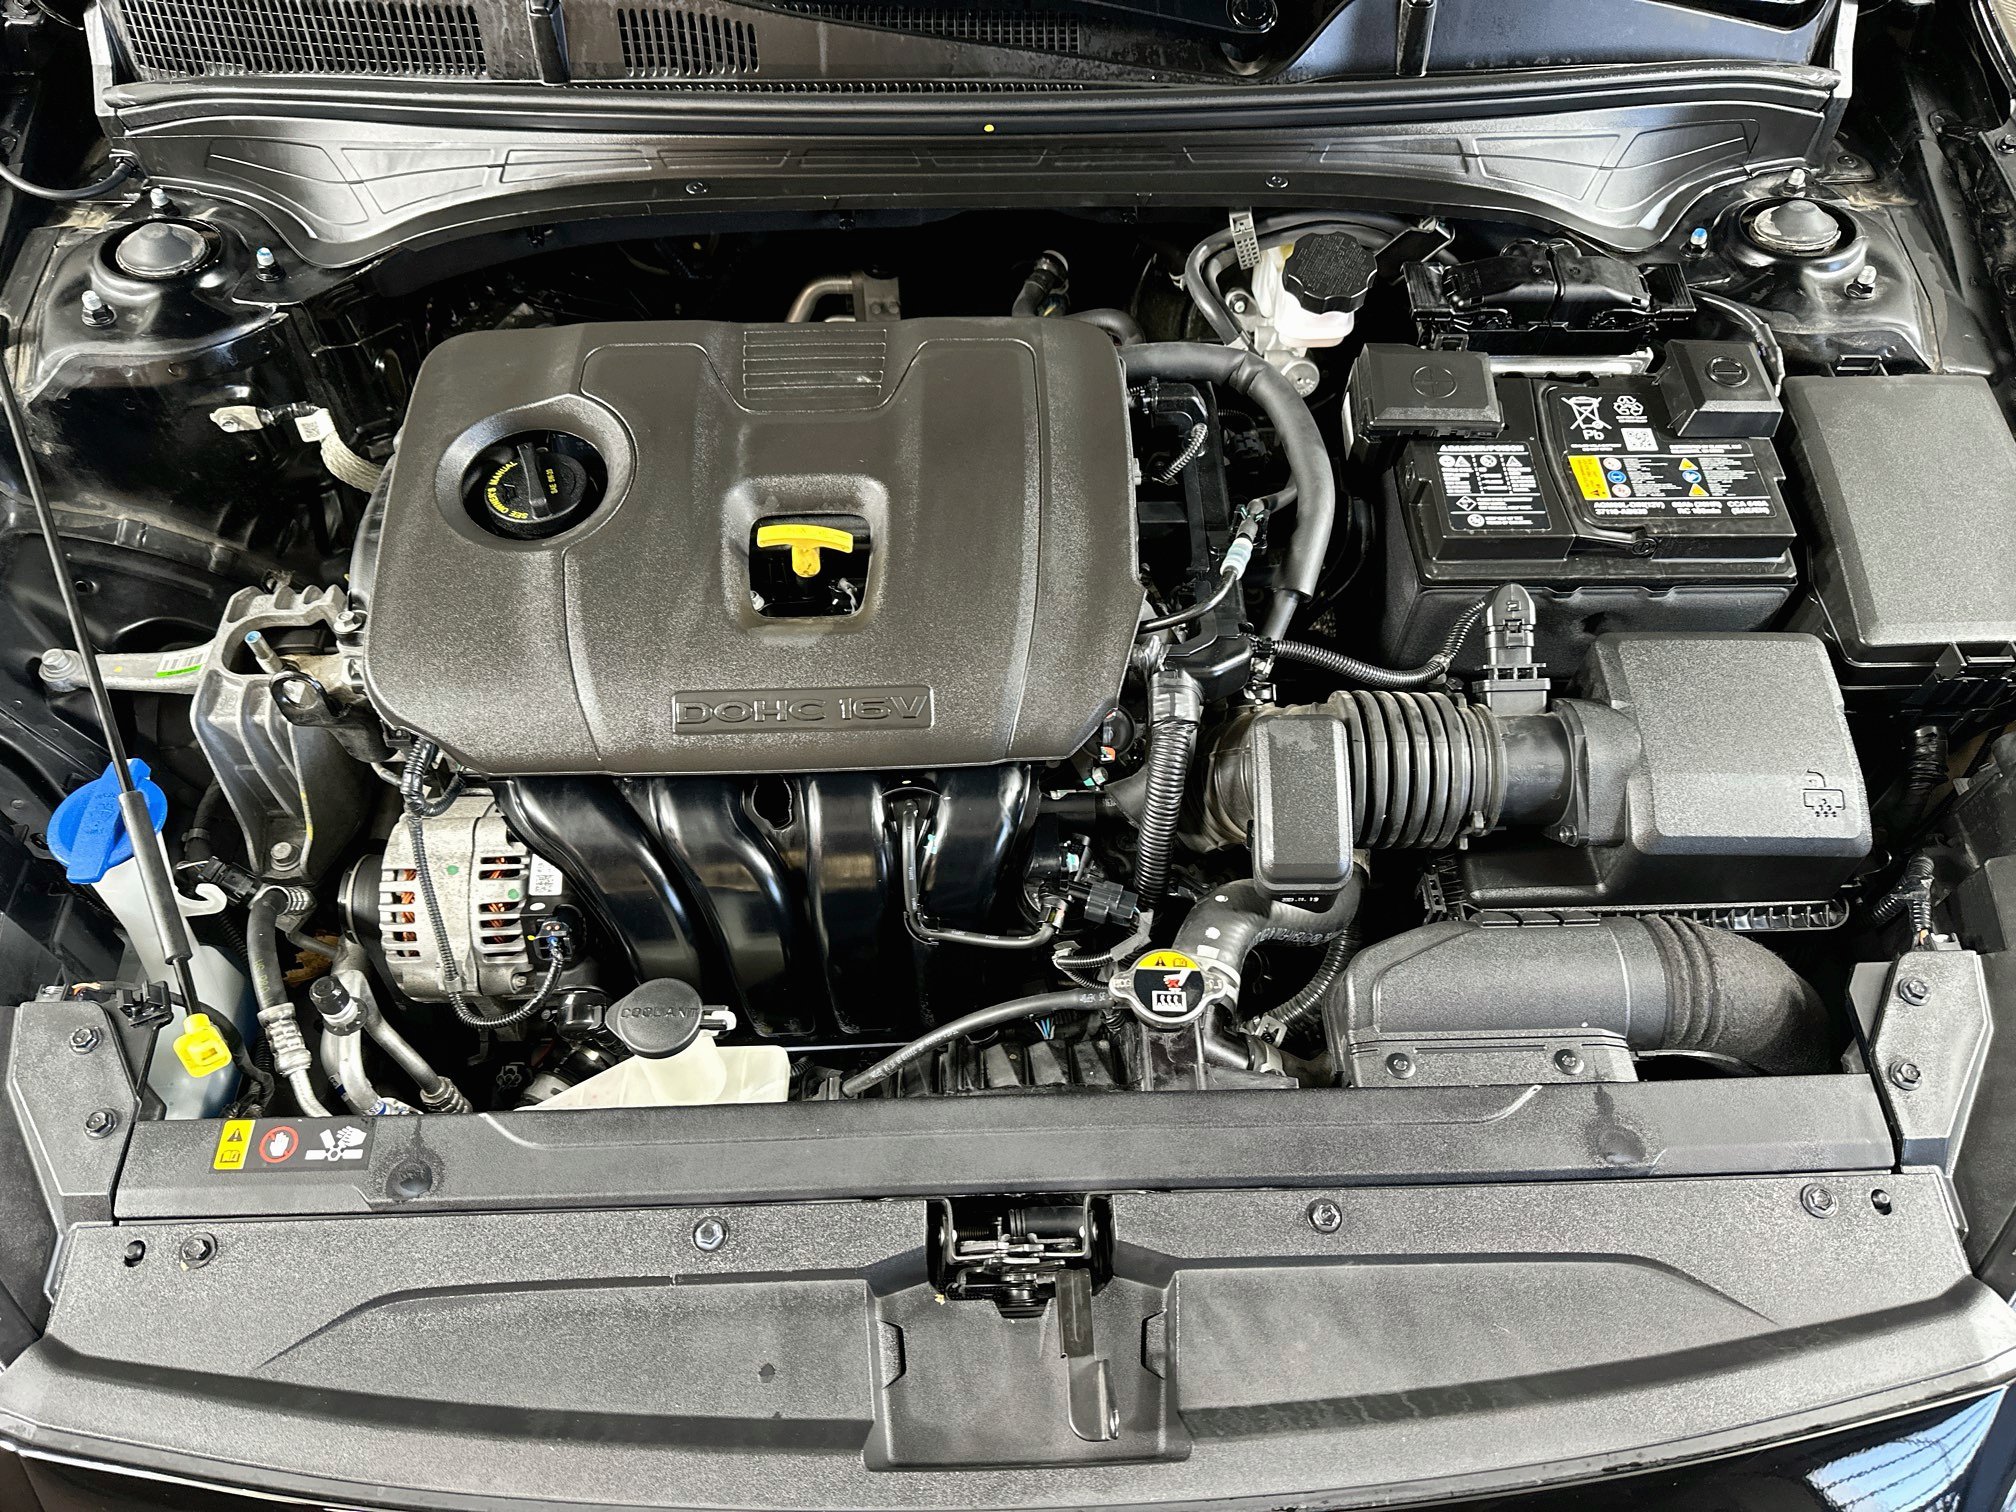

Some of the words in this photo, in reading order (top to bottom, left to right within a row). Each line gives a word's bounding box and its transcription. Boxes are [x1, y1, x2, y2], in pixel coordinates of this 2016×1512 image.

[1583, 429, 1605, 441] Pb
[489, 461, 518, 485] MANUAL
[487, 487, 509, 514] OWNER'S
[508, 510, 529, 519] SEE
[675, 698, 827, 724] DOHC
[838, 695, 928, 720] 16V
[620, 1006, 700, 1019] COOLANT
